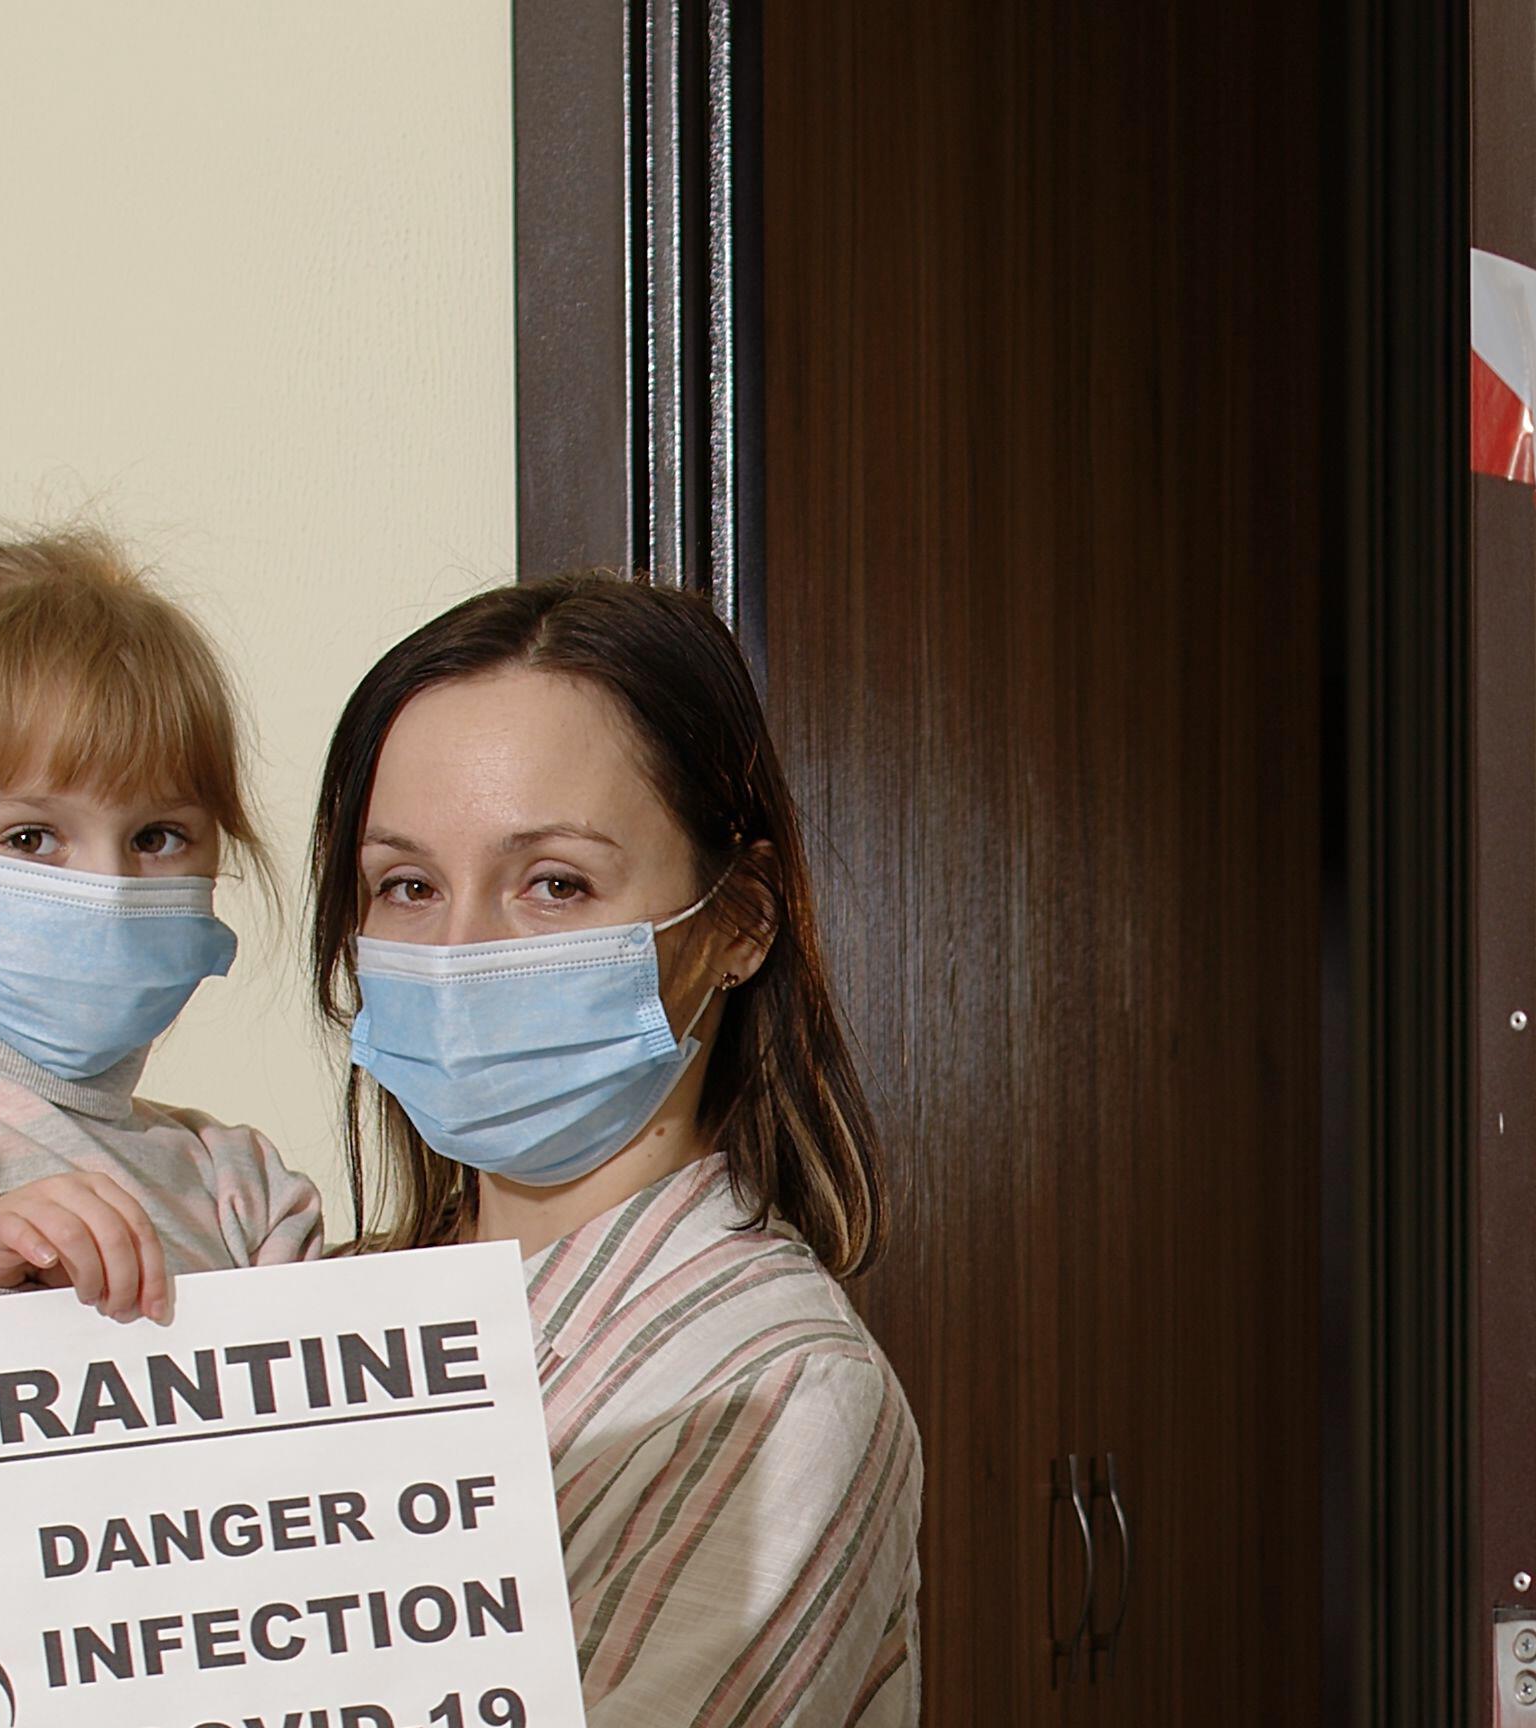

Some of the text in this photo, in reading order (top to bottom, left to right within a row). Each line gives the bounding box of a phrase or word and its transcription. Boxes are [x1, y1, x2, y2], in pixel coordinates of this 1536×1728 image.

[38, 1475, 496, 1579] DANGER OF
[42, 1576, 524, 1688] INFECTION
